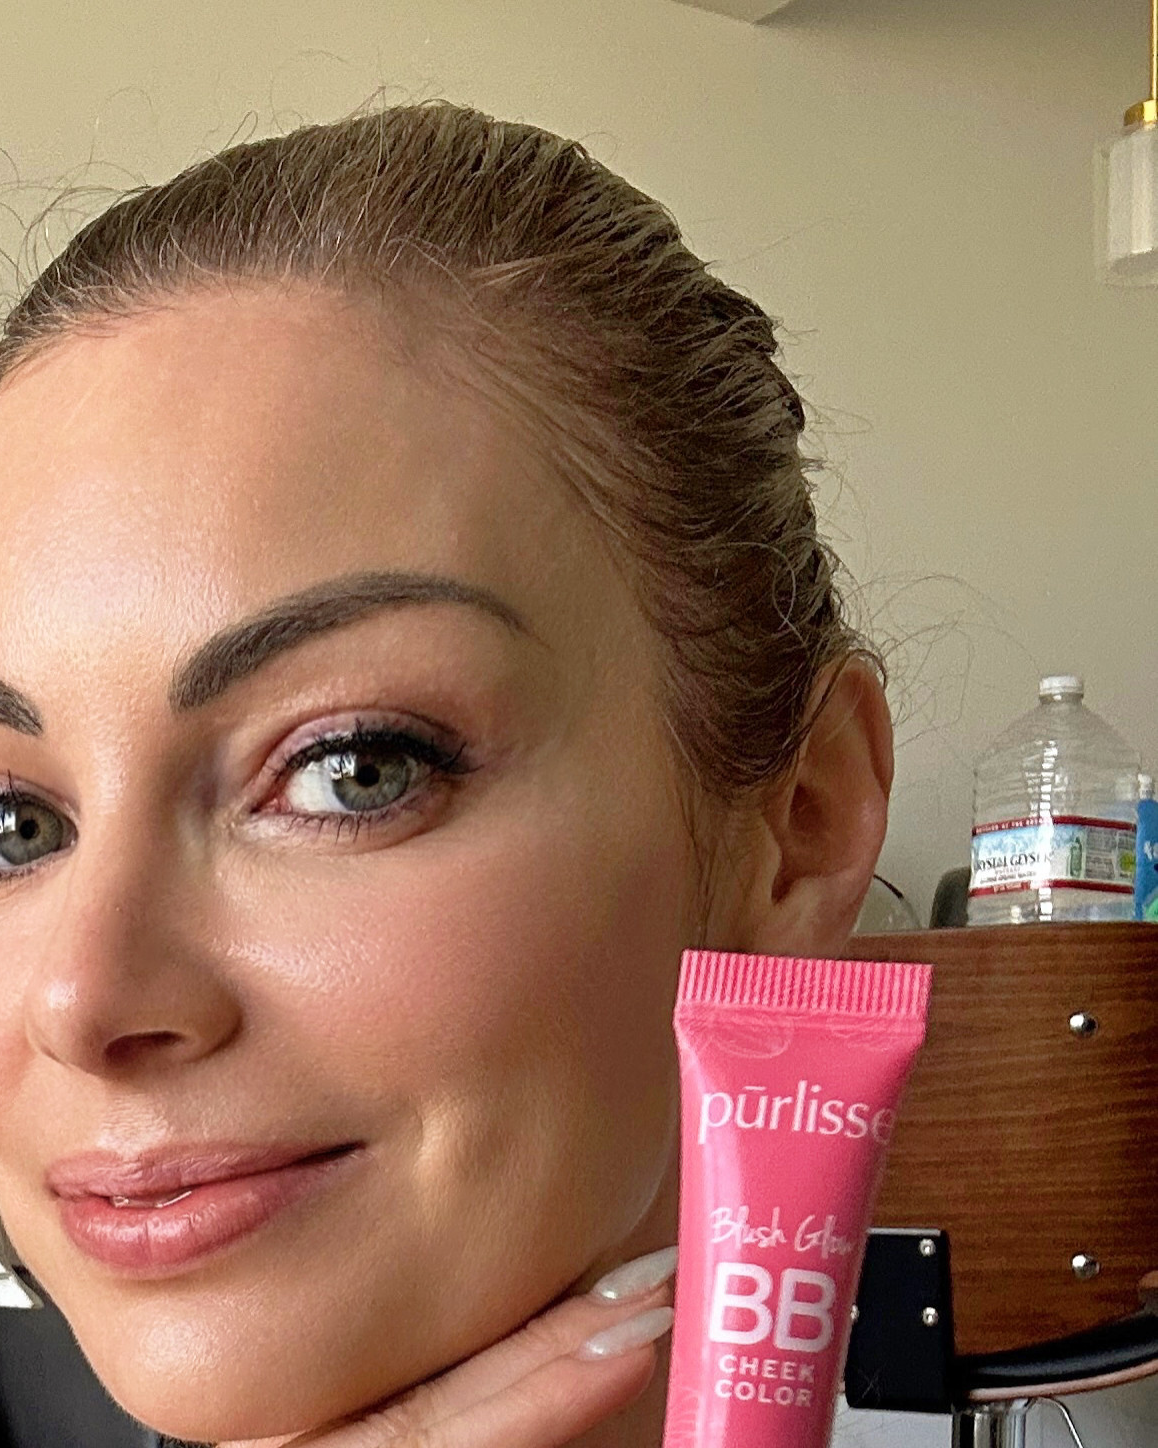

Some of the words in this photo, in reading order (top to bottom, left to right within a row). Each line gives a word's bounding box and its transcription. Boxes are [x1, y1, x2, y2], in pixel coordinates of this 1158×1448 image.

[697, 1079, 895, 1145] pūrlisse
[709, 1205, 787, 1249] Blush
[708, 1261, 837, 1353] BB
[717, 1354, 816, 1384] CHEEK
[714, 1379, 813, 1408] COLOR
